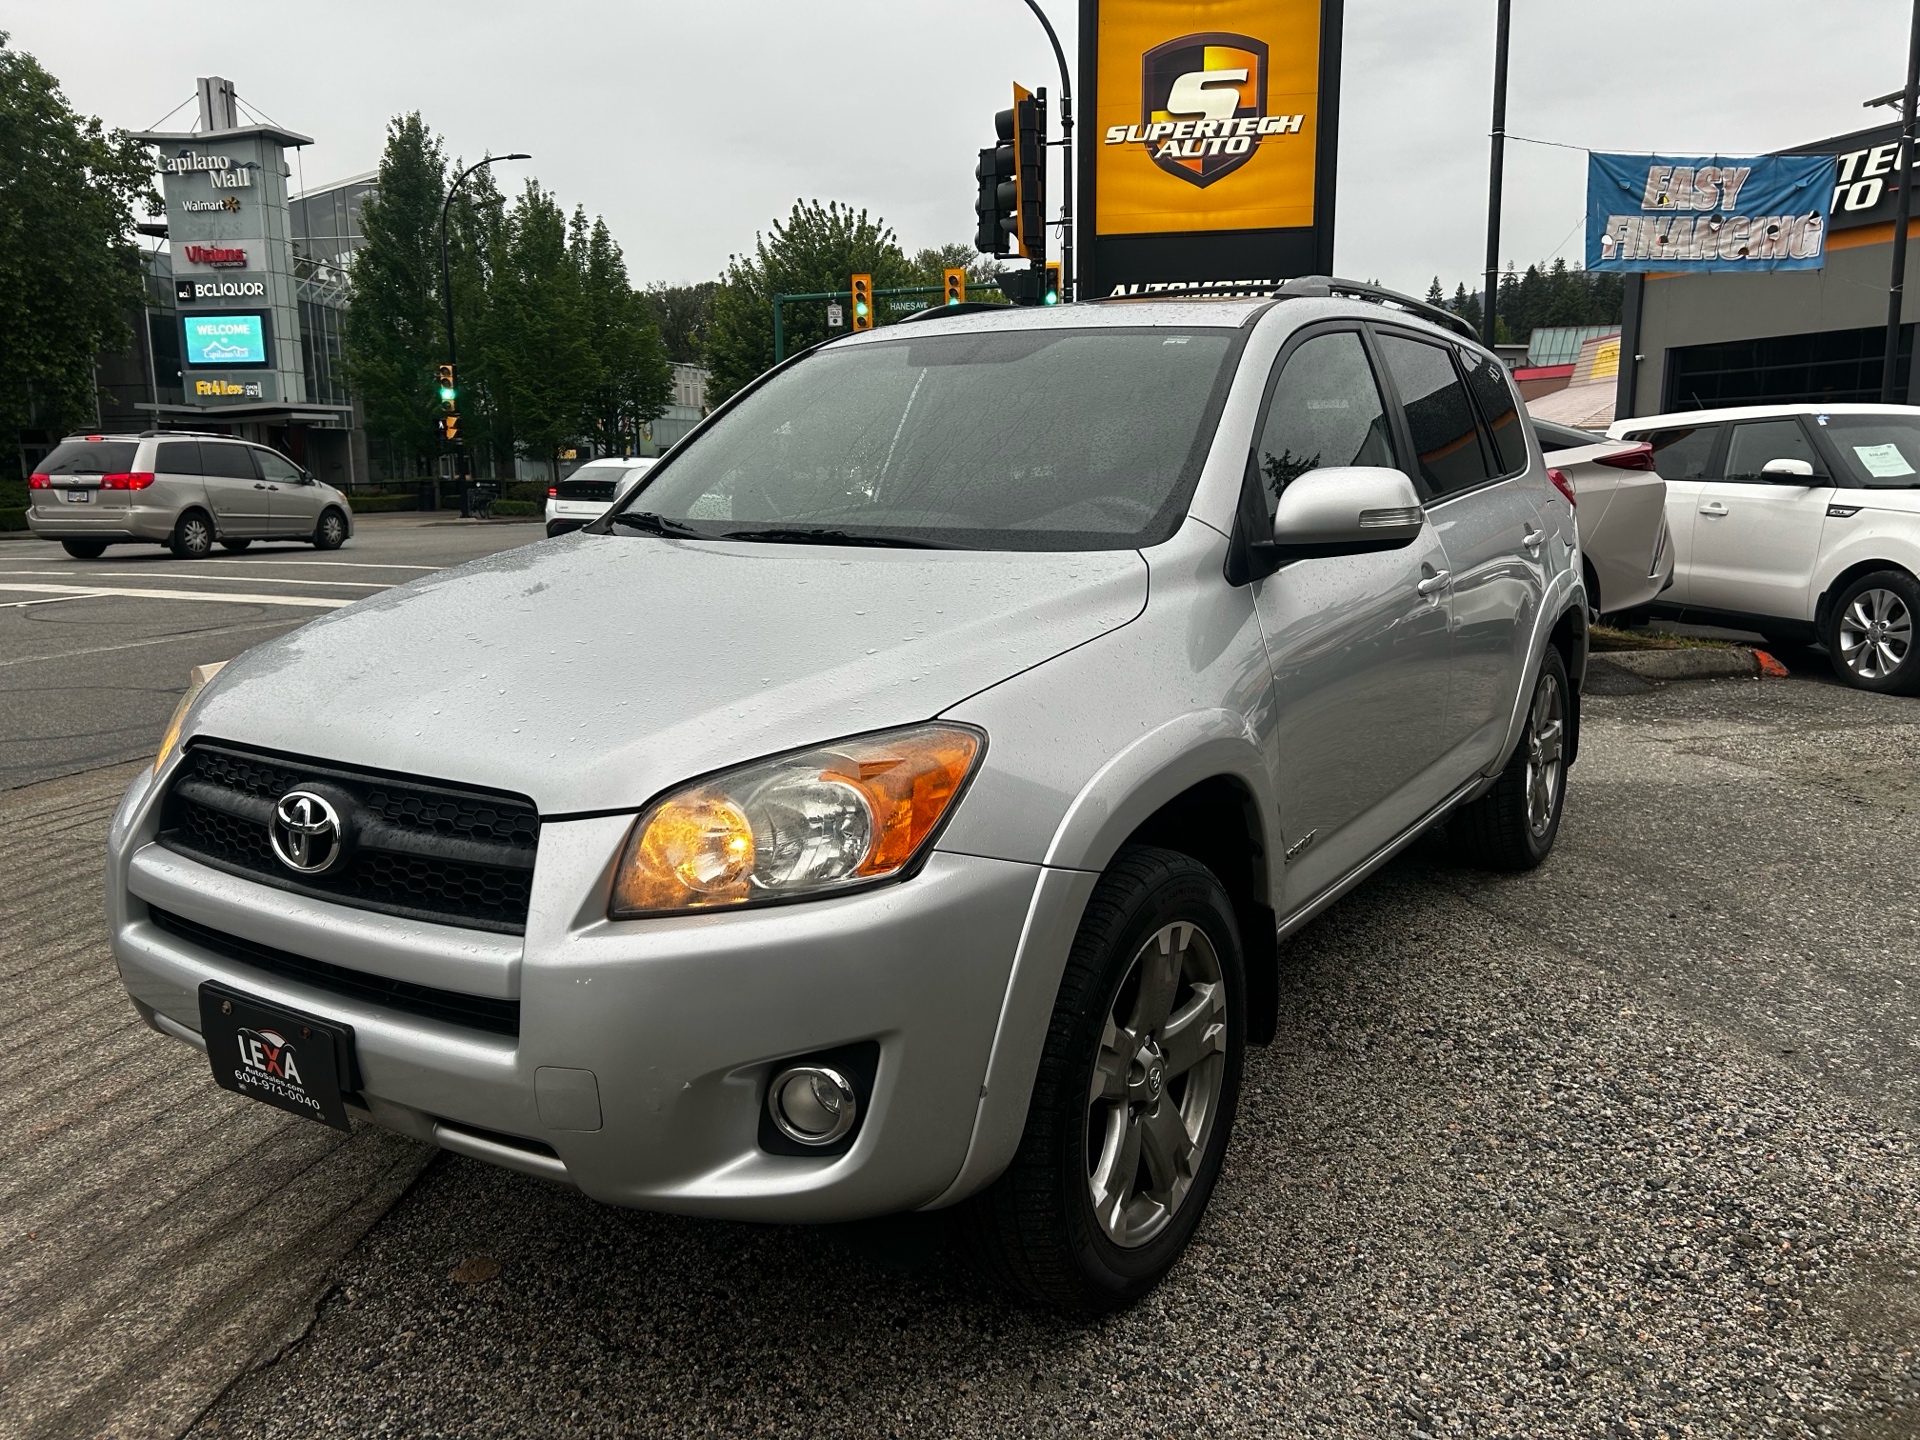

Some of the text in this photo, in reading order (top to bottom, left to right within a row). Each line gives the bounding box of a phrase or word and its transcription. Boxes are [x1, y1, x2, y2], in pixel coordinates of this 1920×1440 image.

[1104, 114, 1306, 144] SUPERTECH
[1154, 136, 1252, 159] AUTO
[156, 151, 231, 176] Capilano
[208, 167, 251, 189] Mall
[1641, 165, 1751, 211] EASY
[182, 199, 225, 212] Walmart
[1601, 214, 1825, 261] FINANCING
[890, 301, 929, 311] HANES AVE
[196, 324, 251, 335] WELCOME
[237, 1034, 303, 1085] LEXA
[234, 1069, 321, 1110] 604-971-0040
[245, 1066, 306, 1095] AutoSales.com
